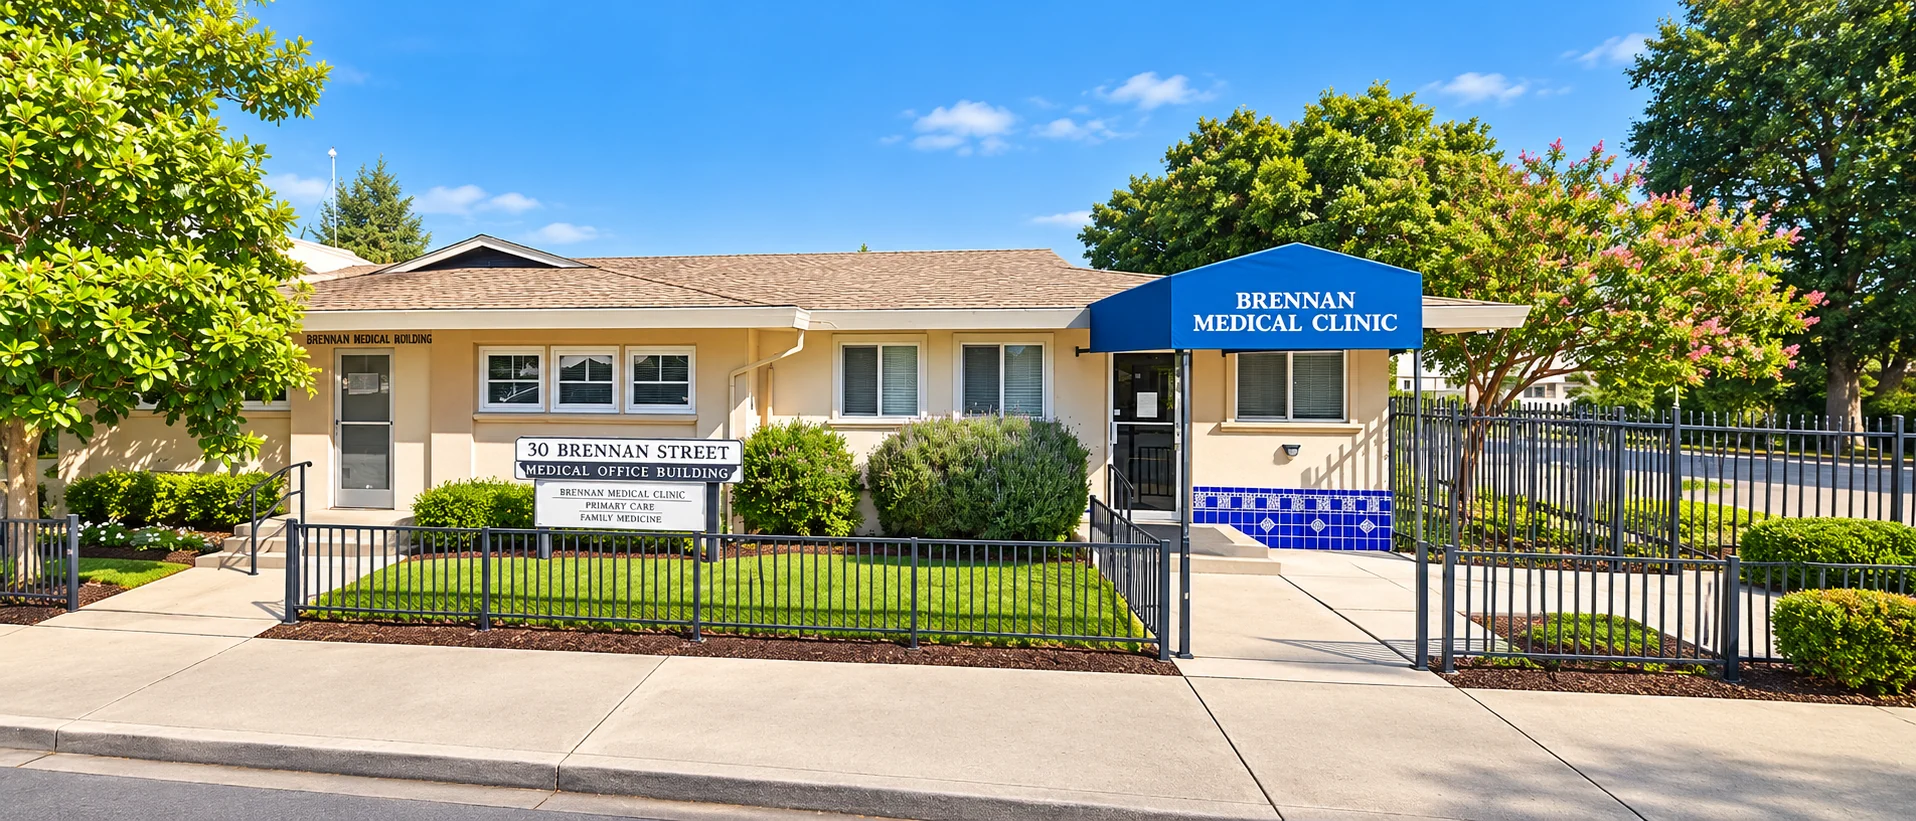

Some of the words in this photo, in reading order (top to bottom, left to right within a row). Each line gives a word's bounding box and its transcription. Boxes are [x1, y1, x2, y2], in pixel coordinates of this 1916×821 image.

[1236, 291, 1356, 310] BRENNAN
[1193, 314, 1303, 332] MEDICAL
[1312, 313, 1398, 332] CLINIC
[306, 334, 350, 345] BRENNAN
[353, 334, 391, 344] MEDICAL
[527, 442, 549, 457] 30
[557, 443, 649, 459] BRENNAN
[657, 444, 730, 460] STREET
[526, 464, 590, 477] MEDICAL
[597, 465, 649, 478] OFFICE
[656, 466, 728, 479] BUILDING
[560, 488, 605, 498] BRENNAN
[607, 489, 650, 499] MEDICAL
[653, 490, 686, 500] CLINIC
[585, 501, 627, 511] PRIMARY
[629, 502, 655, 511] CARE
[580, 513, 613, 522] FAMILY
[616, 514, 662, 524] MEDICINE
